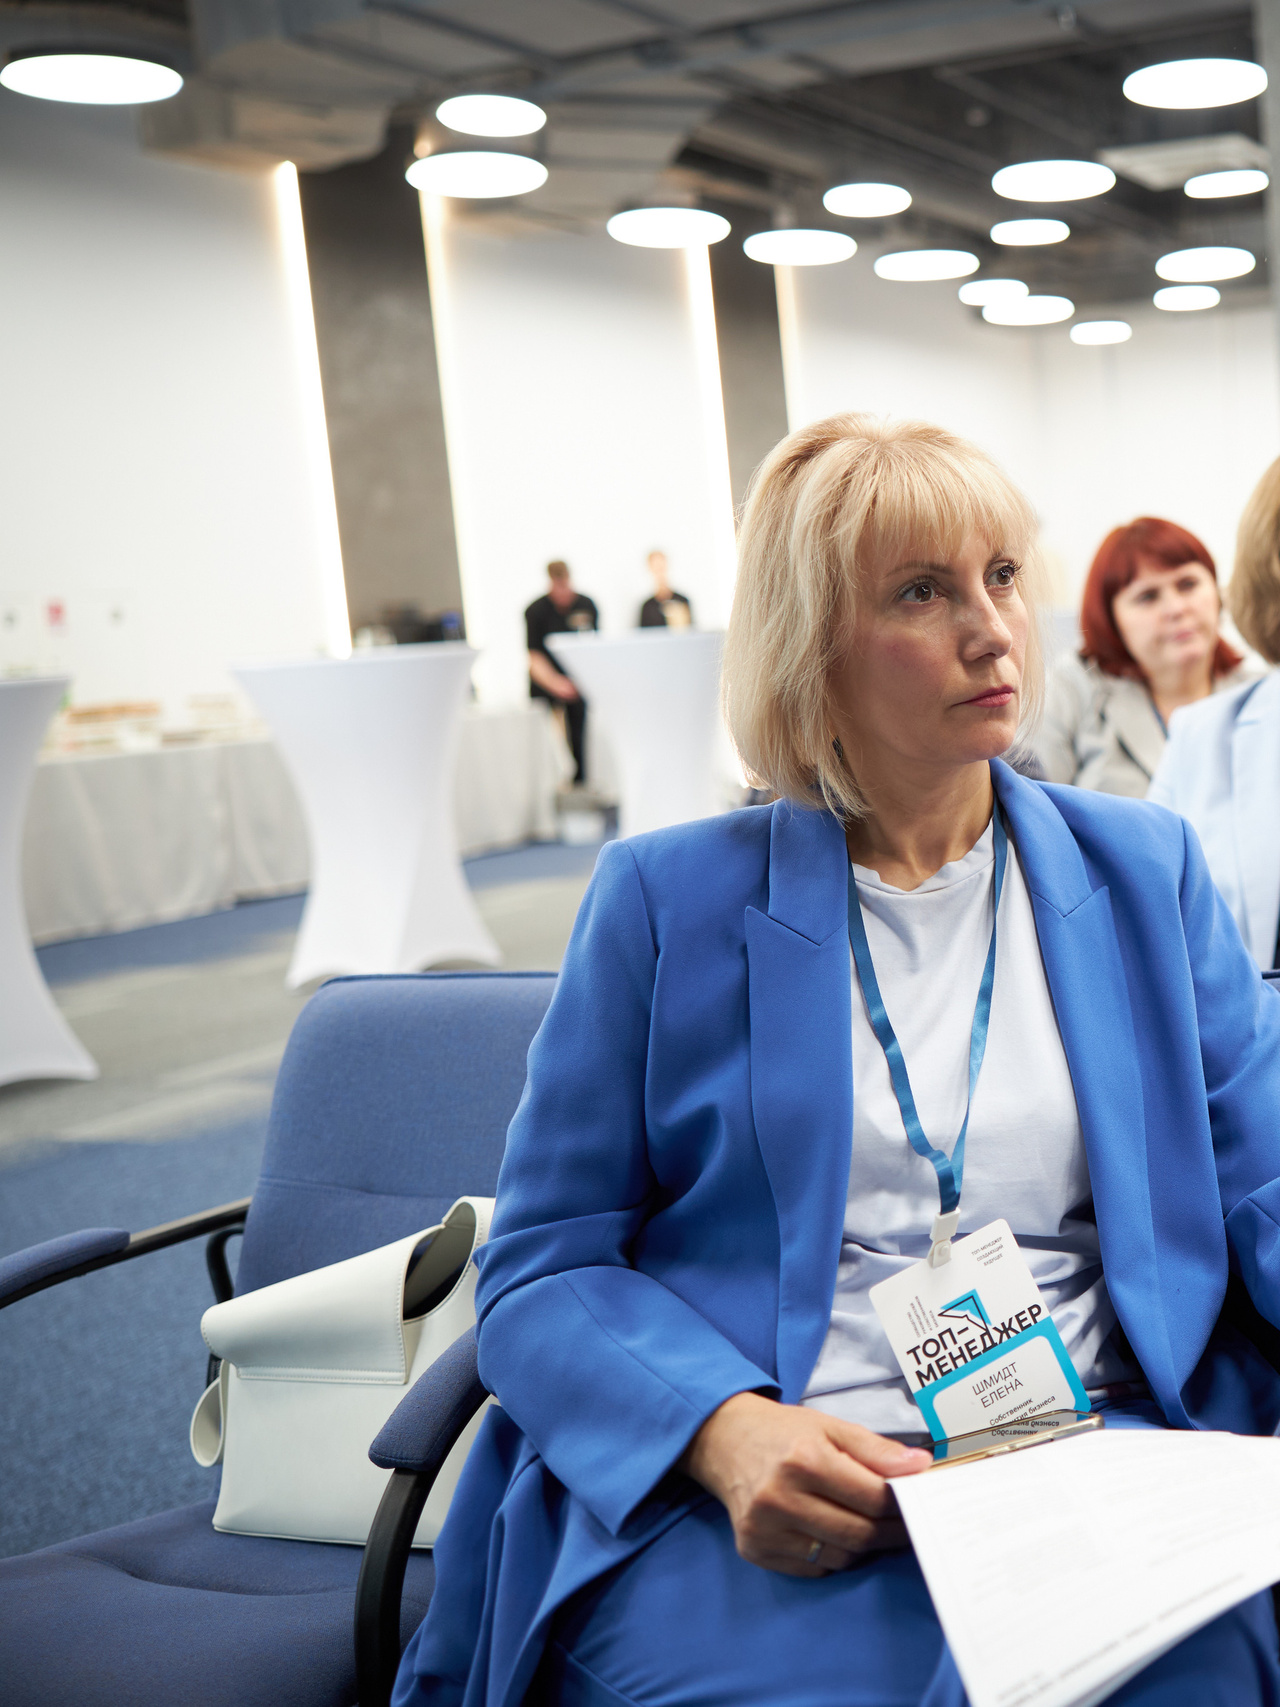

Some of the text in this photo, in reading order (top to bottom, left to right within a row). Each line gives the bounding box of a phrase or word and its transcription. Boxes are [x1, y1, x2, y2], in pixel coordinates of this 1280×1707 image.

[906, 1326, 969, 1366] ТОП-
[915, 1303, 1042, 1388] МЕНЕДЖЕР
[972, 1361, 1018, 1396] ШМИДТ
[980, 1378, 1024, 1408] ЕЛЕНА
[989, 1398, 1033, 1426] Собственник
[1028, 1395, 1056, 1414] бизнеса
